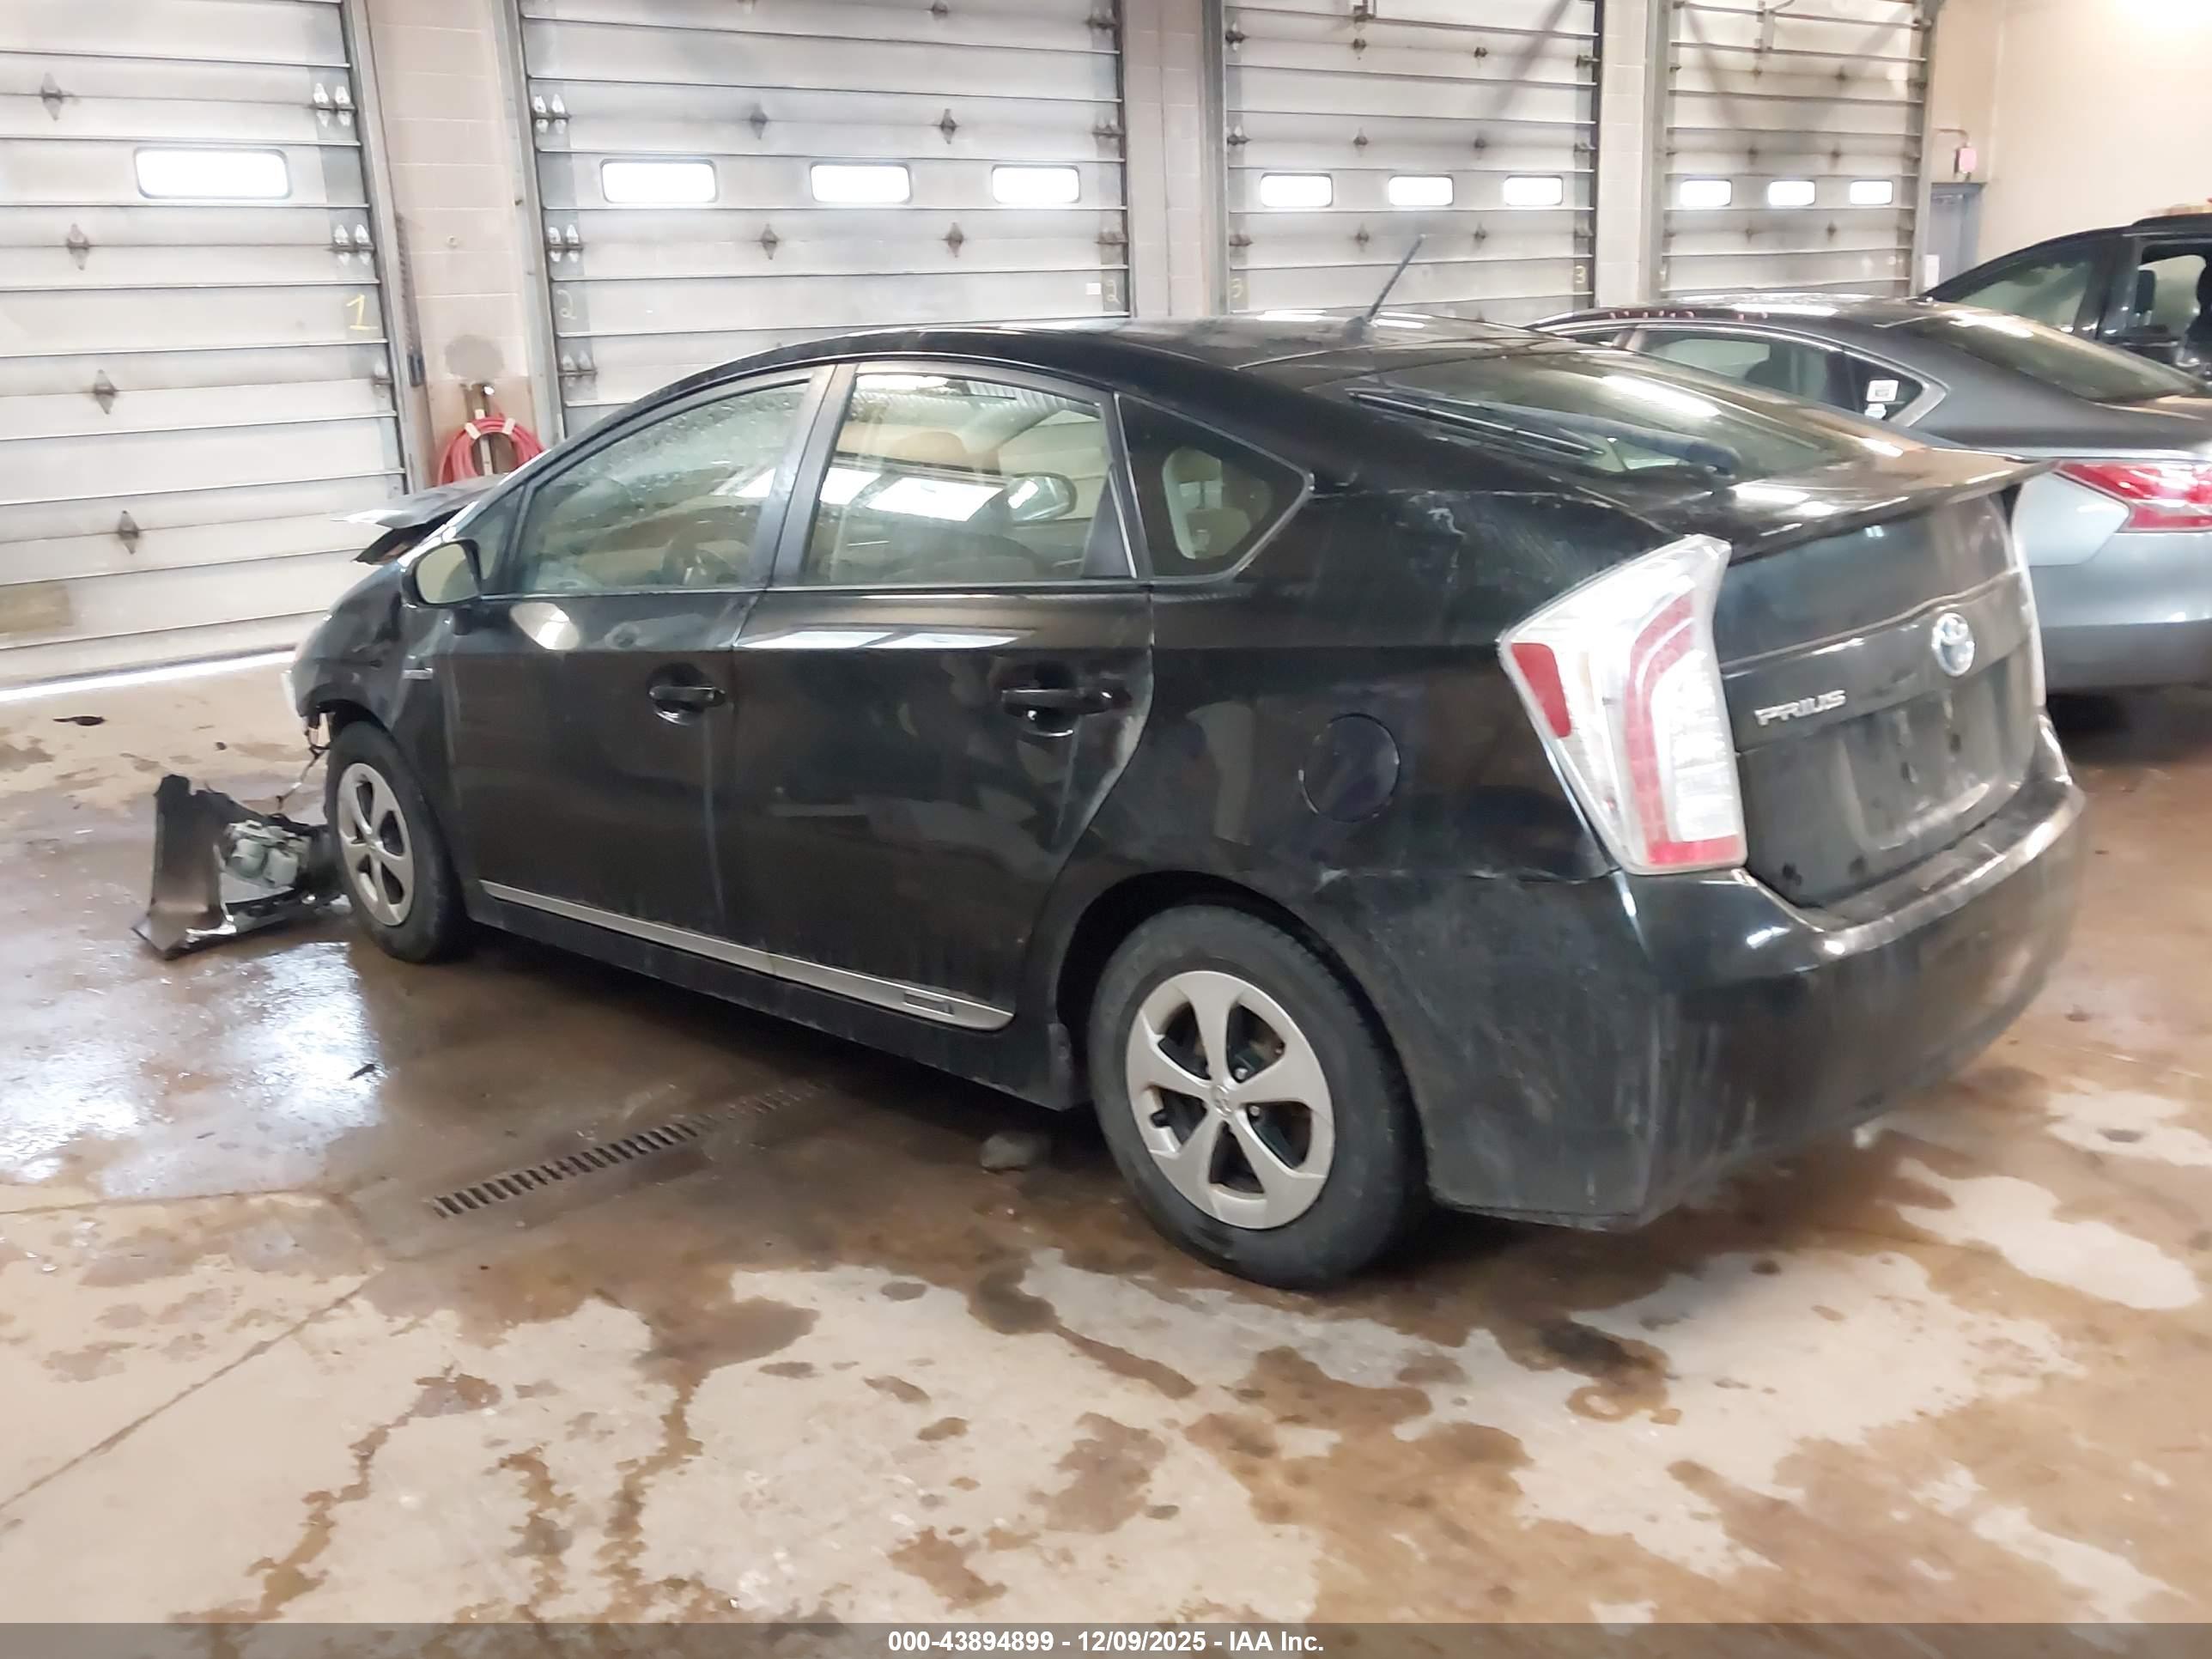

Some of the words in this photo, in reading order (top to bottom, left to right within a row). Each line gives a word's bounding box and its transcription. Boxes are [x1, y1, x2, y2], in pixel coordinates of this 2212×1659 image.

[1575, 265, 1586, 283] 3
[345, 294, 378, 331] 1
[556, 289, 577, 319] 2
[1754, 690, 1846, 726] PRIUS
